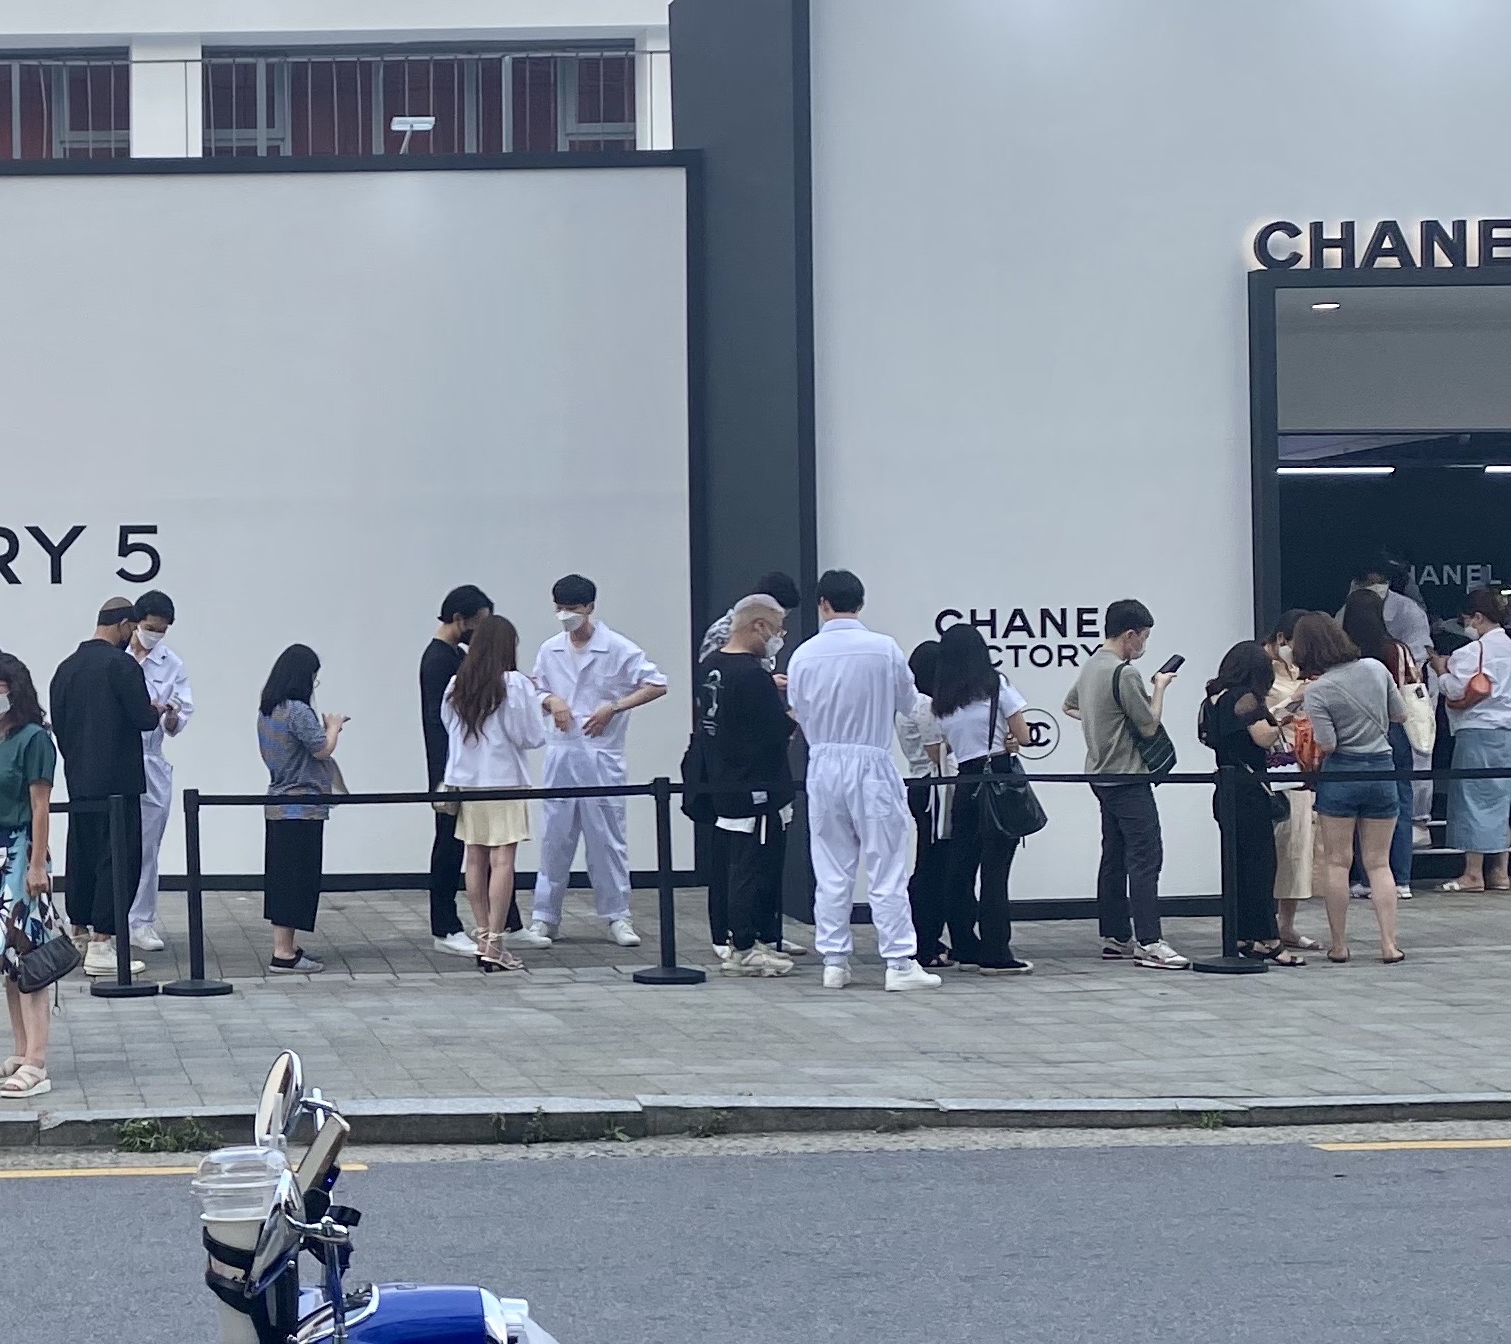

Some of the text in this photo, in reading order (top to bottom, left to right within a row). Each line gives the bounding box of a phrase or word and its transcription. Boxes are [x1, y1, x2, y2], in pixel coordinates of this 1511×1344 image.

[116, 524, 161, 583] 5
[934, 607, 1100, 640] CHANE
[988, 644, 1104, 668] CTORY
